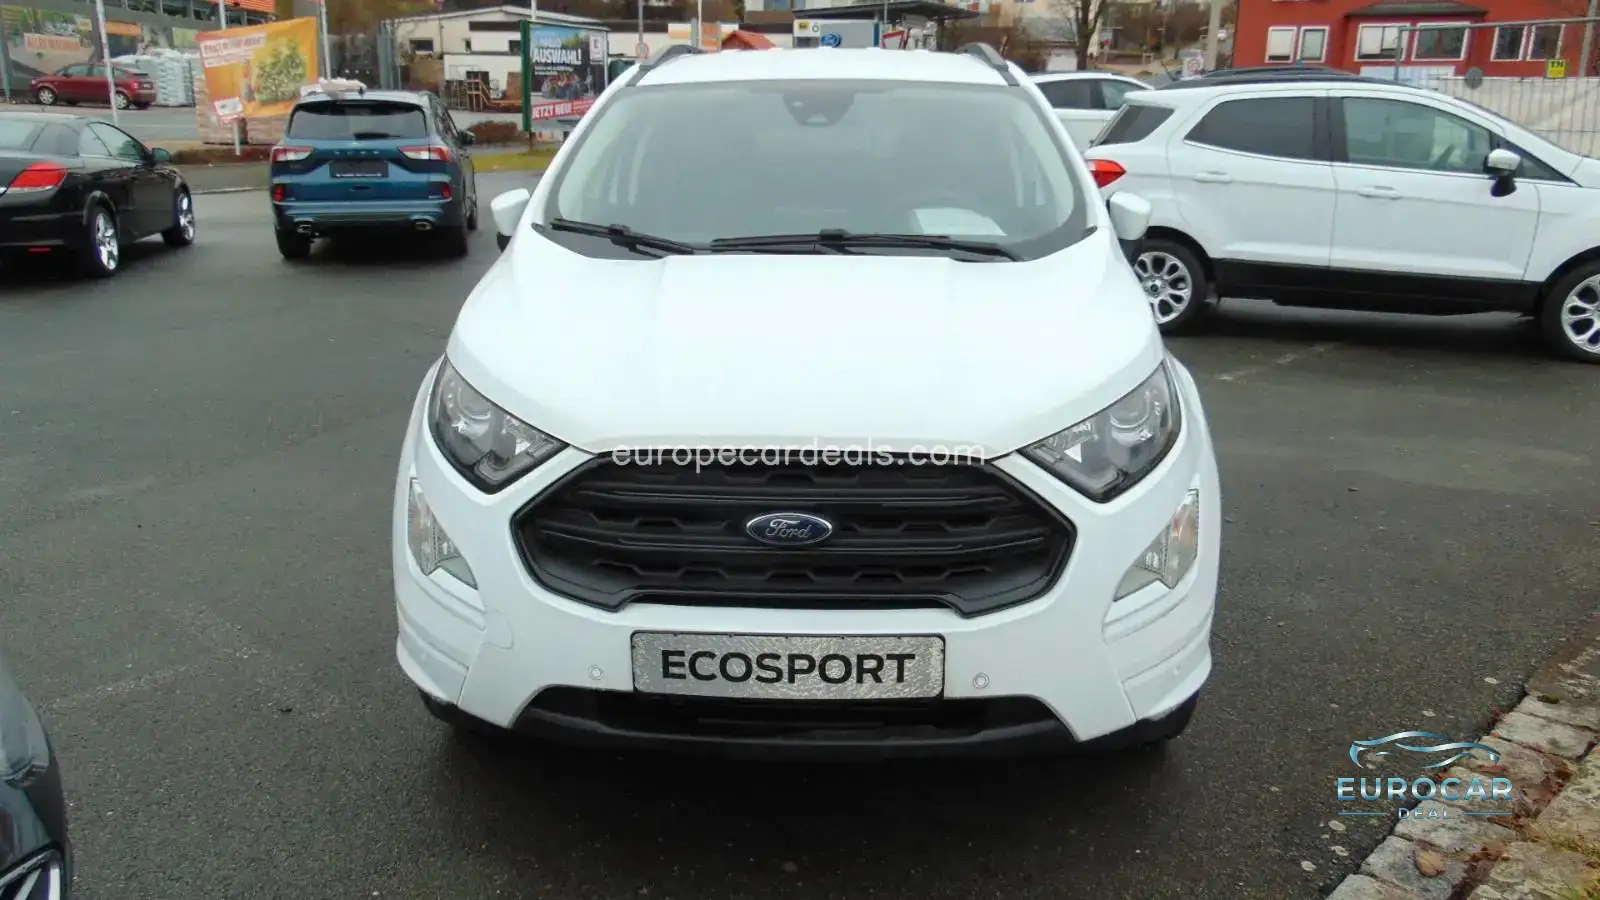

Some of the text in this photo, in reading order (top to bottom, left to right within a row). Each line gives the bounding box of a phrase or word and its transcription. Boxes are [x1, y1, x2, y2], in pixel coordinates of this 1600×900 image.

[532, 48, 582, 65] AUSWAHL!
[764, 518, 813, 539] Ford
[661, 649, 916, 685] ECOSPORT
